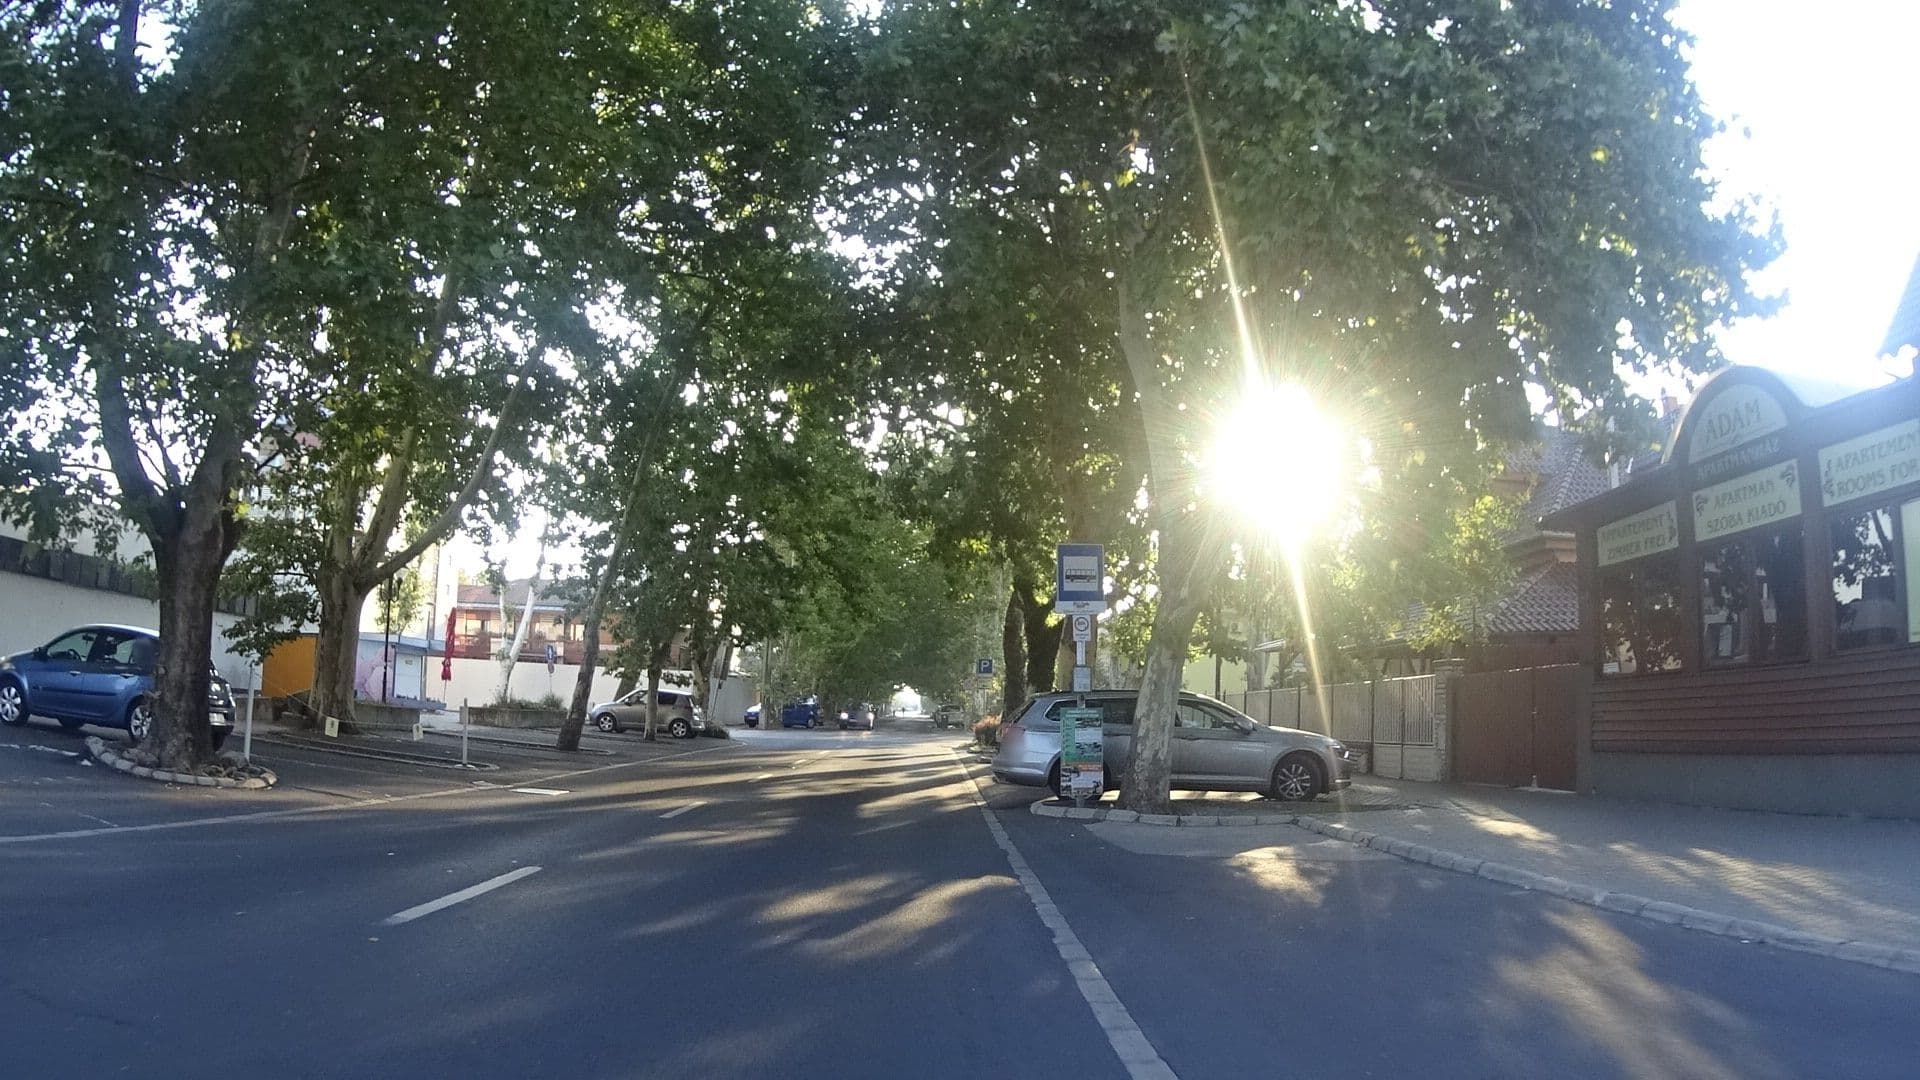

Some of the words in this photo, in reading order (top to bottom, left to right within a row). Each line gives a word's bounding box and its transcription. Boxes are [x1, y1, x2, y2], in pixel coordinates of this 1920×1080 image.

[1836, 429, 1920, 472] APARTEMEN
[1837, 467, 1885, 497] ROOMS
[1707, 511, 1744, 533] SZOBA
[1746, 496, 1786, 523] KIADÓ
[1607, 540, 1641, 560] ZIMMER
[981, 660, 990, 672] P
